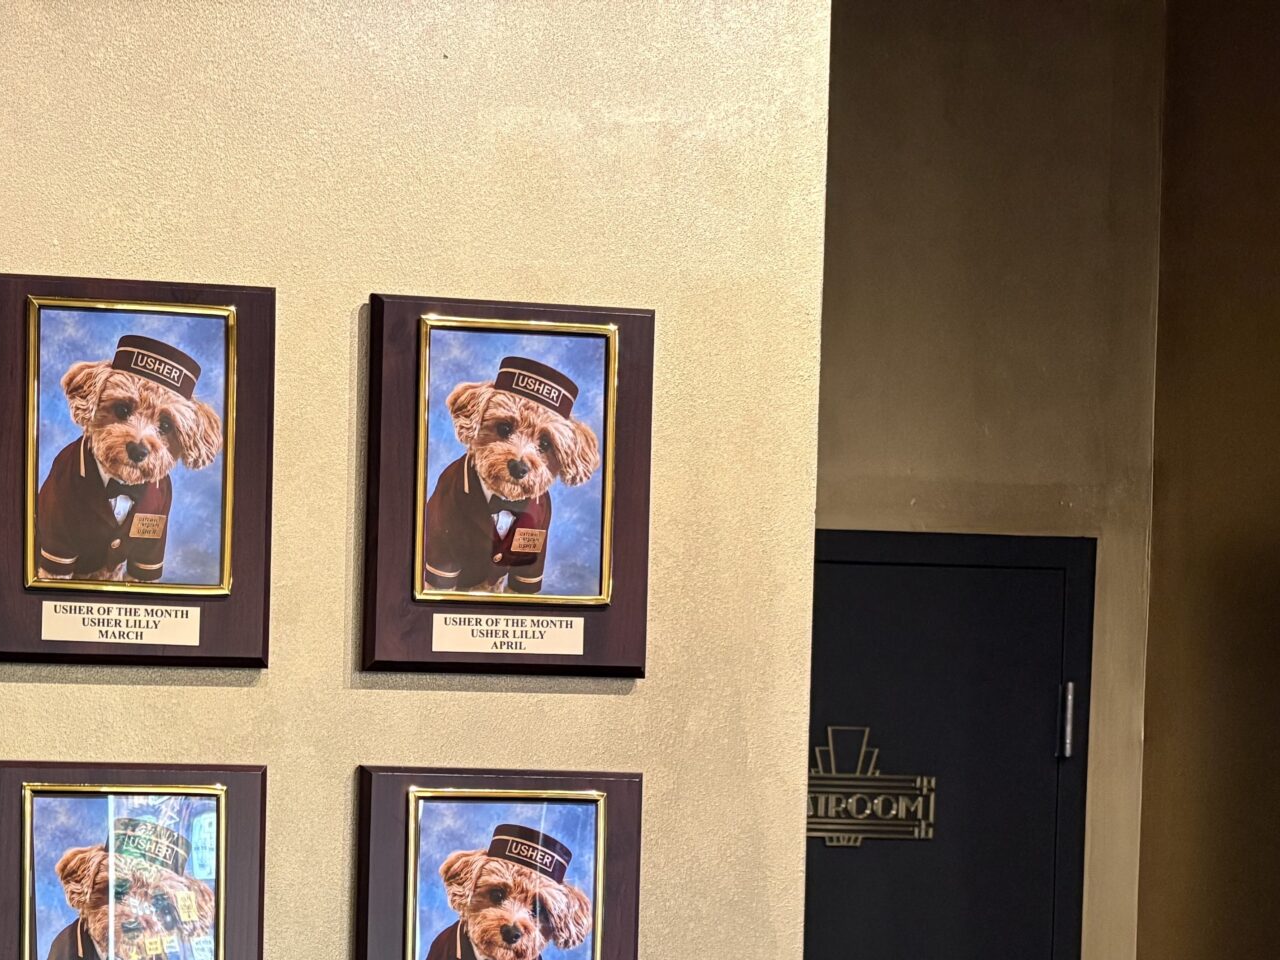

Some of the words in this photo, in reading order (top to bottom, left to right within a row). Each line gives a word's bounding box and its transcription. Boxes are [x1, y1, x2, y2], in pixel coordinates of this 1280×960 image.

[137, 355, 180, 381] USHER
[518, 375, 563, 402] USHER
[53, 604, 94, 615] USHER
[96, 606, 113, 615] OF
[115, 607, 140, 616] THE
[143, 608, 188, 618] MONTH
[82, 617, 122, 627] USHER
[125, 618, 160, 629] LILLY
[444, 616, 482, 626] USHER
[485, 617, 500, 626] OF
[503, 618, 527, 627] THE
[530, 618, 573, 628] MONTH
[98, 629, 143, 640] MARCH
[471, 628, 509, 638] USHER
[512, 629, 546, 639] LILLY
[491, 640, 526, 650] APRIL
[130, 836, 172, 859] USHER
[511, 842, 556, 868] USHER
